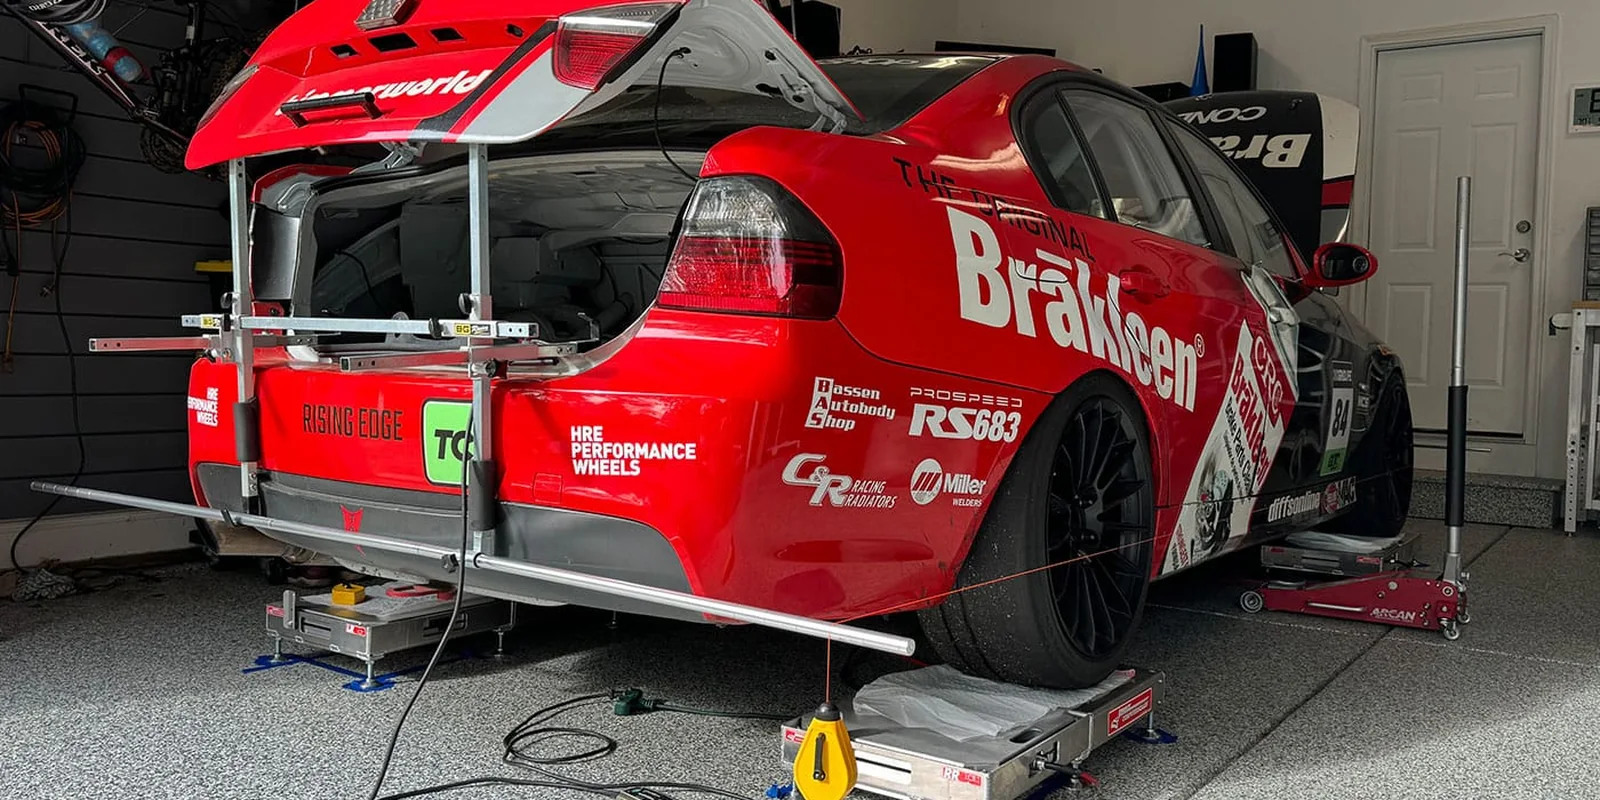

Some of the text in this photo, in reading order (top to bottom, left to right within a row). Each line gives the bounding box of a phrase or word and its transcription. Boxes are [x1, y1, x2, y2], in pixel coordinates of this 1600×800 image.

[891, 156, 957, 200] THE
[972, 189, 1096, 263] ORIGINAL
[1255, 336, 1283, 414] CRC
[816, 377, 881, 400] Bassen
[910, 387, 1023, 408] PROSPEED
[813, 396, 896, 420] Autobody
[1331, 399, 1350, 438] 84
[303, 403, 403, 441] RISING EDGE
[806, 412, 856, 431] Shop
[909, 403, 1022, 443] RS683
[571, 426, 604, 442] HRE
[571, 442, 697, 460] PERFORMANCE
[572, 459, 641, 476] WHEELS
[781, 453, 853, 507] C&R
[850, 480, 886, 494] RACING
[942, 472, 987, 495] Miller
[844, 494, 898, 509] RADIATORS
[952, 498, 983, 507] WELDERS
[1370, 607, 1416, 623] ARCAN
